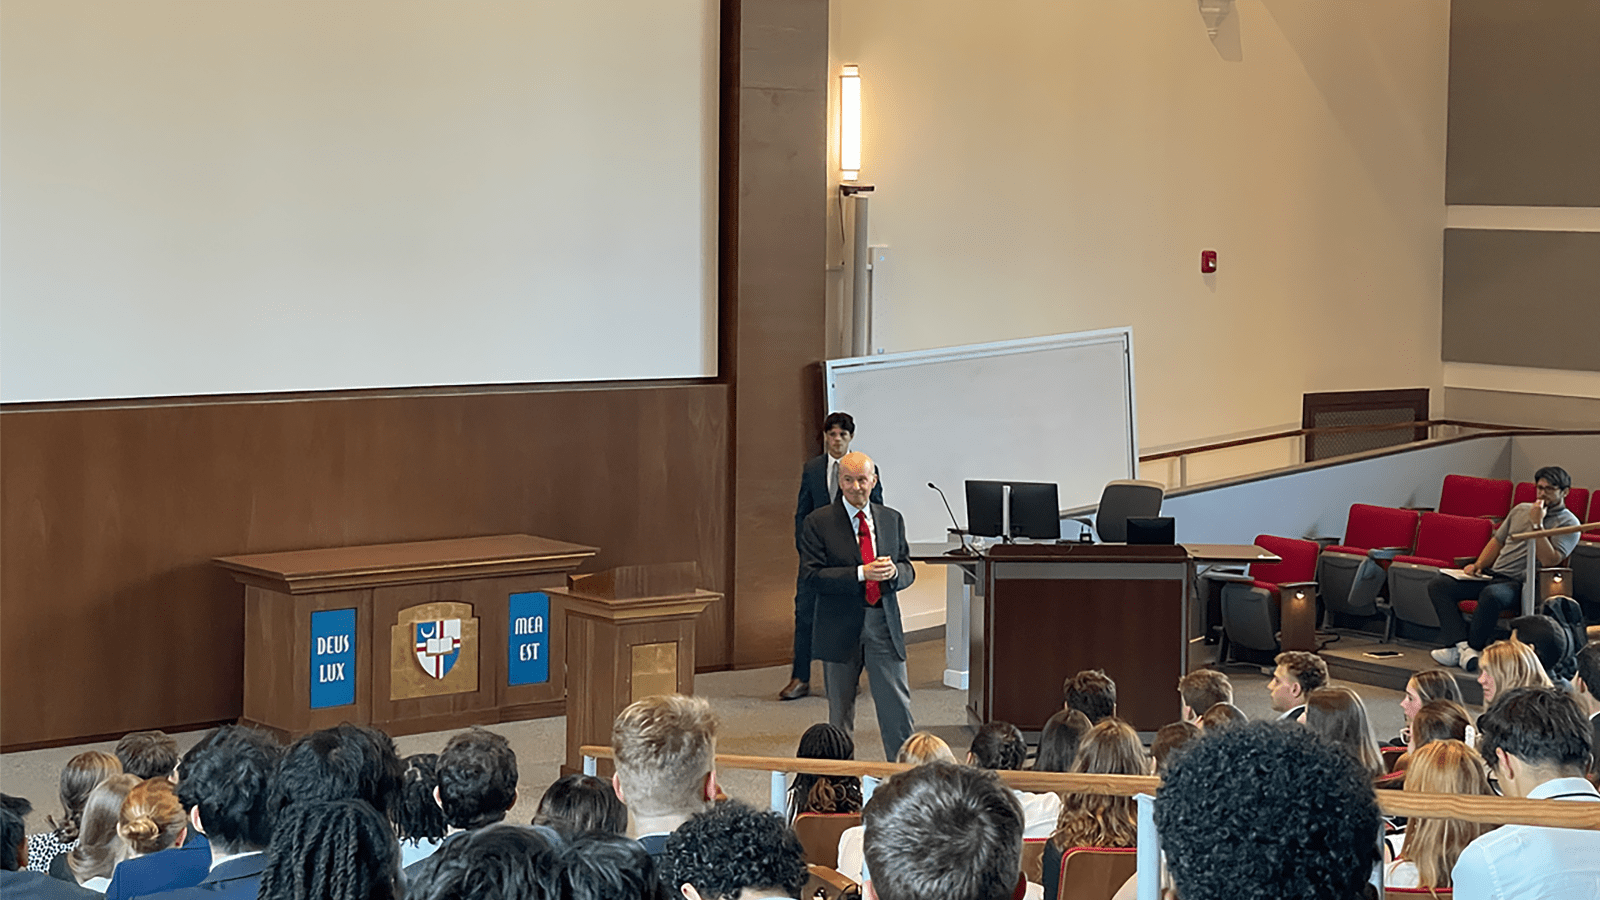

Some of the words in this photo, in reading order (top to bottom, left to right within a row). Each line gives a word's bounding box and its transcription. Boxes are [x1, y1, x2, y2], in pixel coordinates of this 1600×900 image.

[515, 616, 542, 634] MEA
[317, 635, 349, 655] DEUS
[520, 643, 540, 661] EST
[320, 663, 344, 682] LUX
